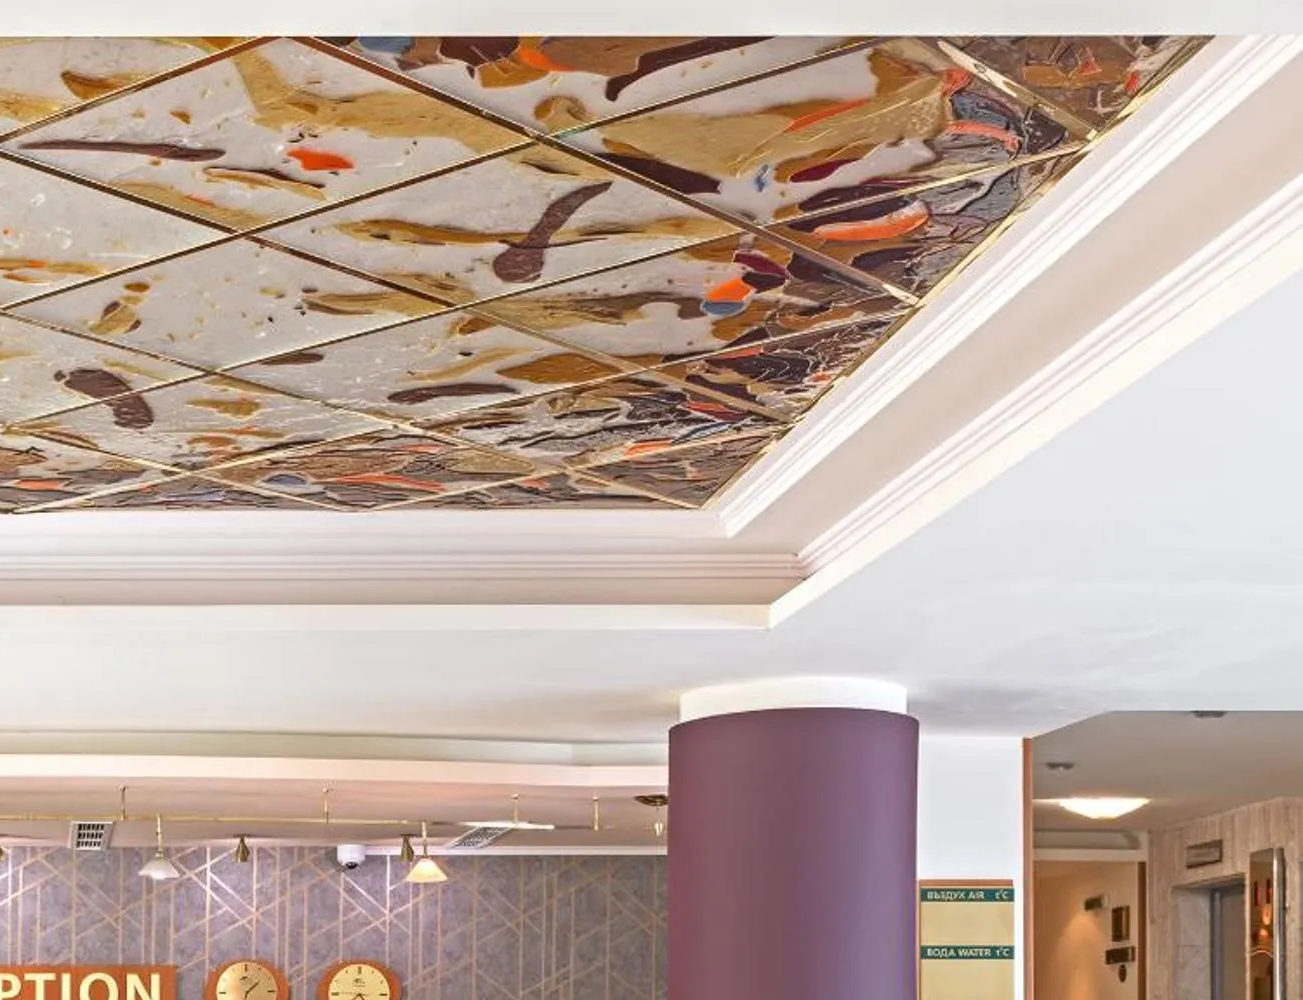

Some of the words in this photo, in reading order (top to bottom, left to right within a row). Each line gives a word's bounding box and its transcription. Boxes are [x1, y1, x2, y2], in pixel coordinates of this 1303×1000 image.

[926, 890, 966, 901] ВЪЗДУХ
[967, 890, 985, 900] AIR
[926, 947, 956, 958] ВОДА
[957, 947, 992, 957] WATER
